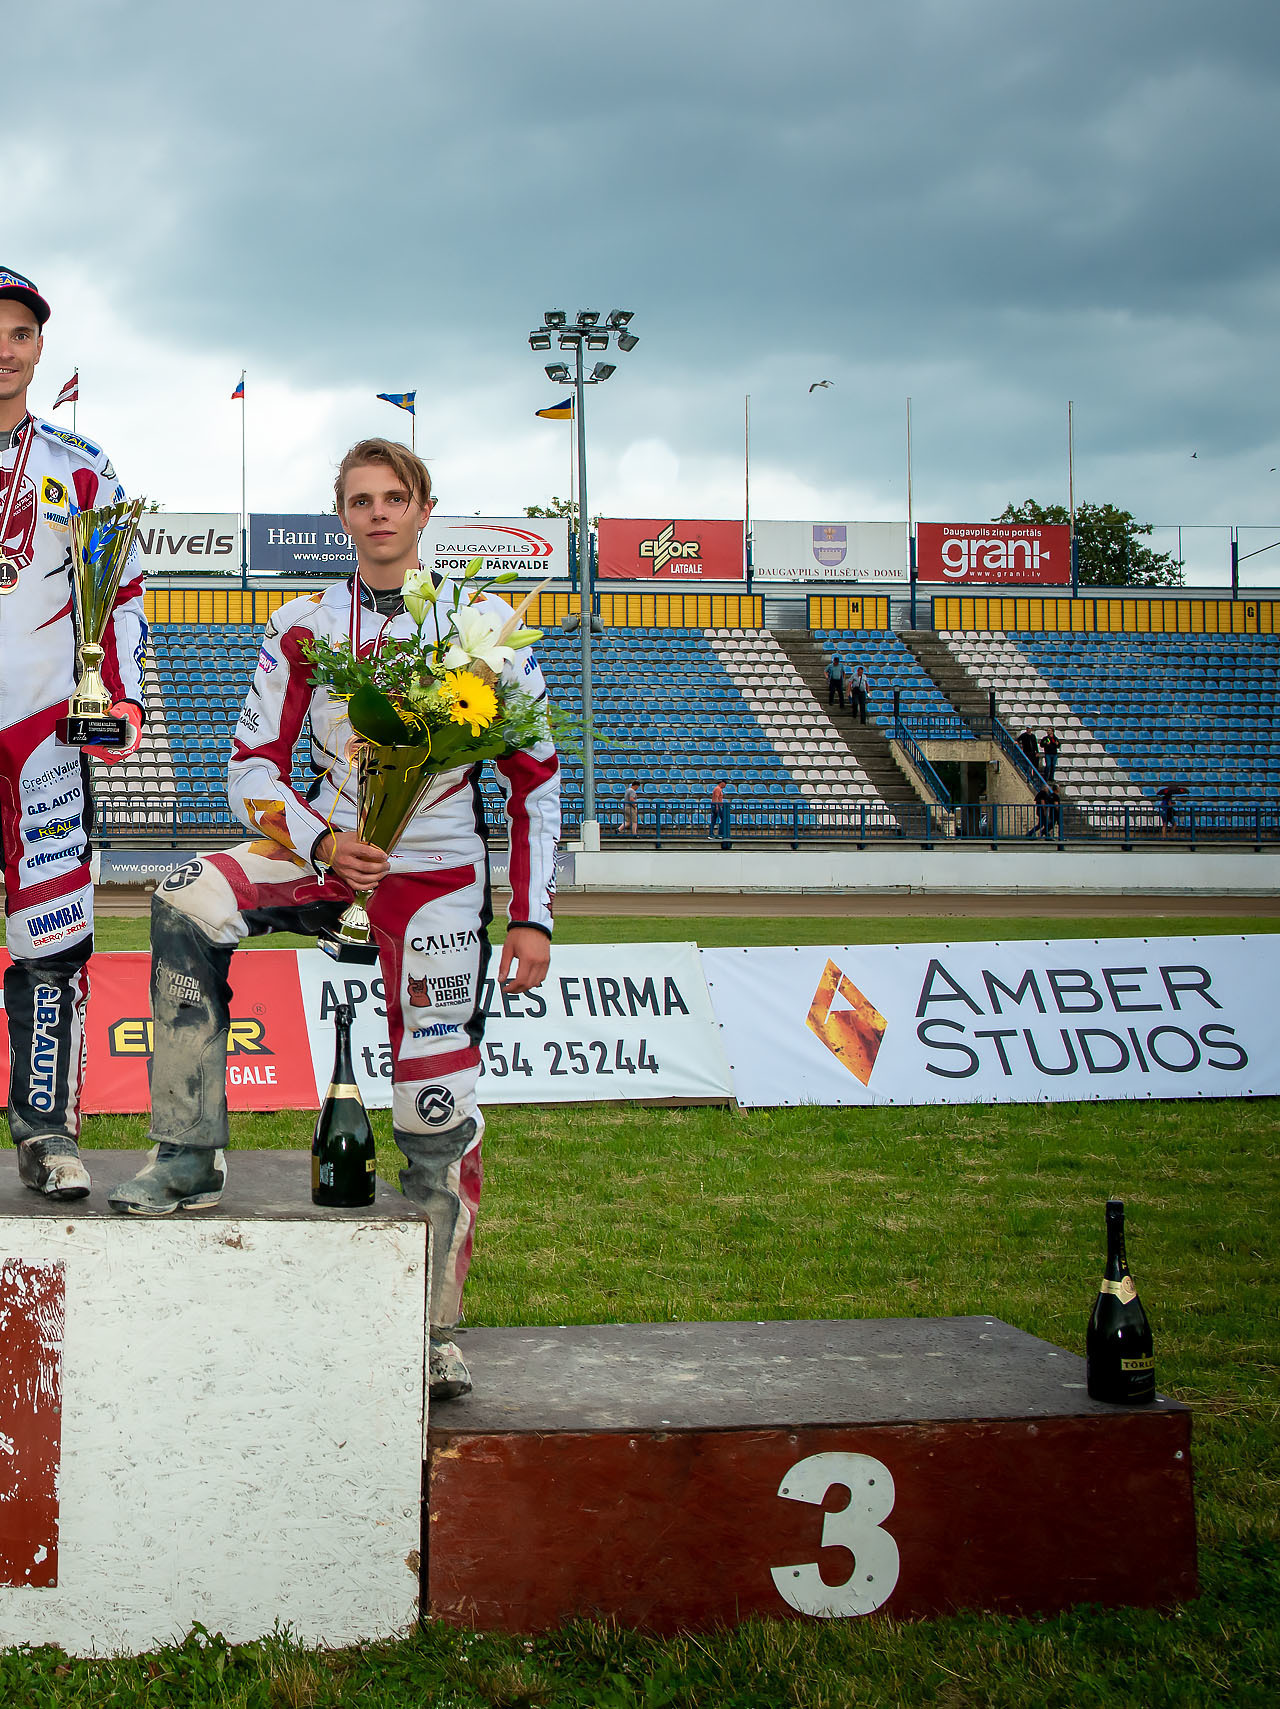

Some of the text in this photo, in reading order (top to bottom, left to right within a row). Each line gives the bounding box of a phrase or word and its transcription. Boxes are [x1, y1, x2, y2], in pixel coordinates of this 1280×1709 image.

[136, 528, 234, 555] Nivels
[268, 528, 317, 545] Наш
[943, 527, 1042, 539] Daugavpils ziņu portāls
[293, 551, 357, 562] www.gorod.
[435, 543, 530, 553] DAUGAVPILS
[486, 558, 549, 570] PĀRVALDE
[941, 538, 1040, 578] grani
[670, 563, 703, 575] LATGALE
[758, 566, 904, 577] DAUGAVPILS PILSĒTAS DOME
[970, 571, 1040, 579] www.grani.lv
[852, 602, 859, 613] H
[1247, 606, 1255, 618] G
[22, 759, 80, 790] CreditValue
[27, 788, 80, 816] G.B. AUTO
[26, 900, 84, 937] UMMBA!
[33, 920, 87, 947] ENERGY DRINK
[429, 973, 471, 990] YOGGY
[915, 959, 1223, 1018] AMBER
[169, 984, 201, 1002] BEAR
[435, 986, 469, 1002] BEAR
[559, 976, 690, 1018] FIRMA
[110, 1018, 273, 1056] ER
[543, 1038, 660, 1077] 25244
[916, 1018, 1249, 1079] STUDIOS
[226, 1070, 279, 1090] GALE
[770, 1451, 901, 1620] 3
